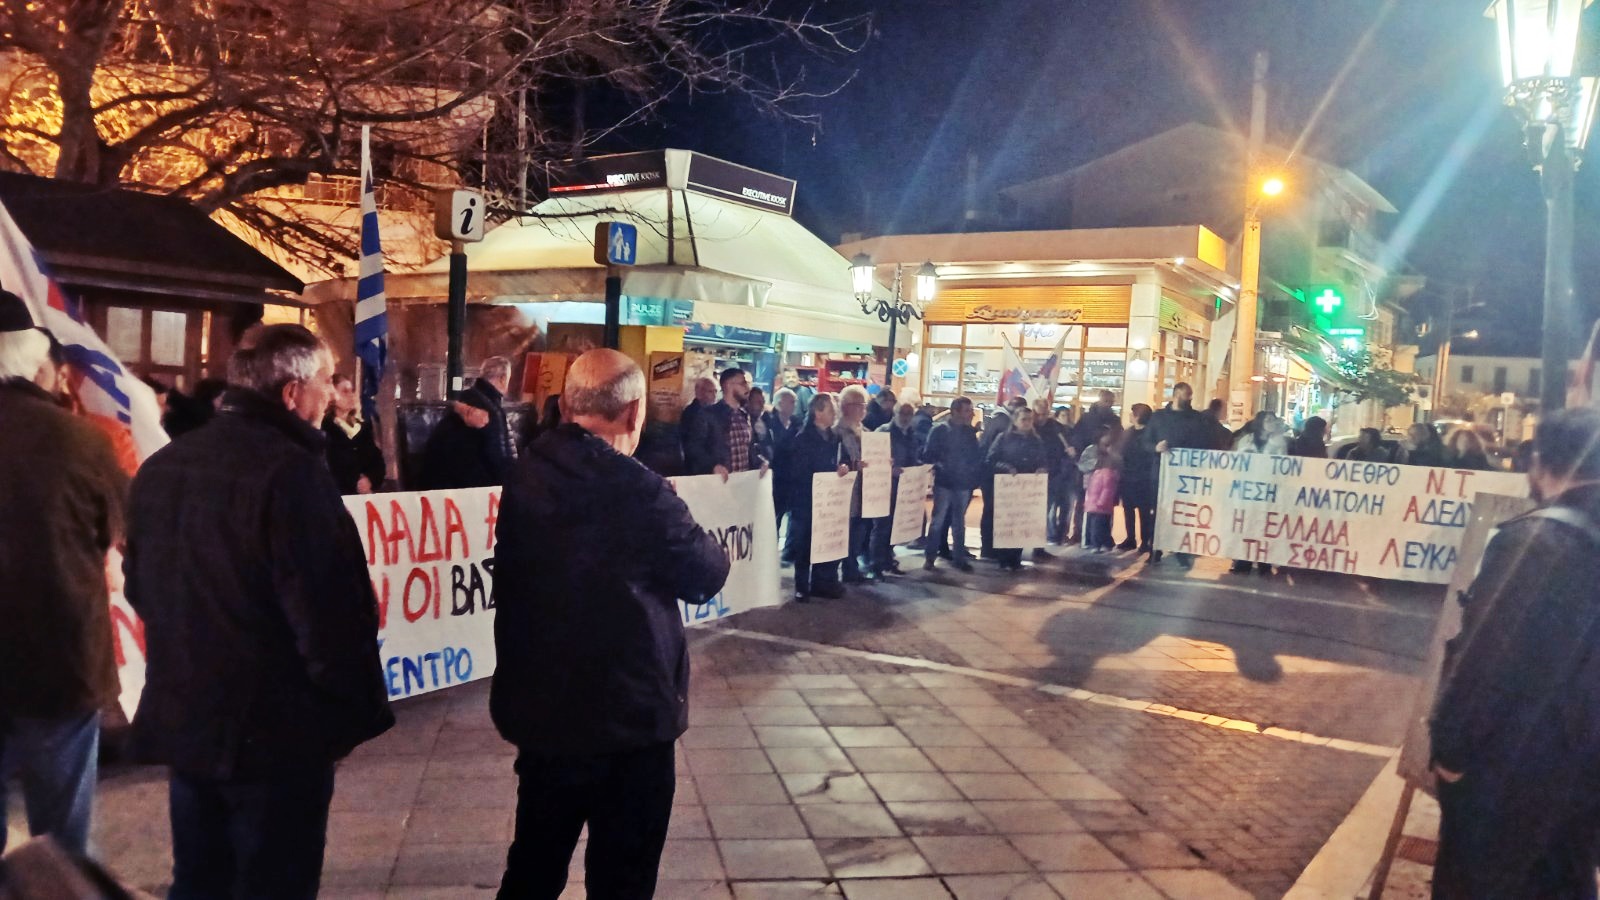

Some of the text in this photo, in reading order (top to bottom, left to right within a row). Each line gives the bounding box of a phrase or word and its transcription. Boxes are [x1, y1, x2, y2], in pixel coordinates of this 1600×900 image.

[606, 173, 640, 184] EXECUTIVE
[742, 186, 787, 206] EXECUTIVE KIOSK
[460, 198, 476, 235] i
[1168, 450, 1400, 486] ΣΠΕΡΝΟΥΝ ΤΟΝ ΟΛΕΘΡΟ
[1177, 475, 1385, 515] ΣΤΗ ΜΕΣΗ ΑΝΑΤΟΛΗ
[366, 496, 469, 566] ΛΑΔΑ
[1171, 500, 1350, 547] ΕΞΩ Η ΕΛΛΑΔΑ
[1179, 531, 1358, 573] ΑΠΟ ΤΗ ΣΦΑΓΗ
[1379, 538, 1457, 571] ΛΕΥΚΑ
[403, 566, 440, 623] ΟΙ
[450, 558, 496, 617] ΒΑΣ
[384, 646, 473, 697] ΕΝΤΡΟ
